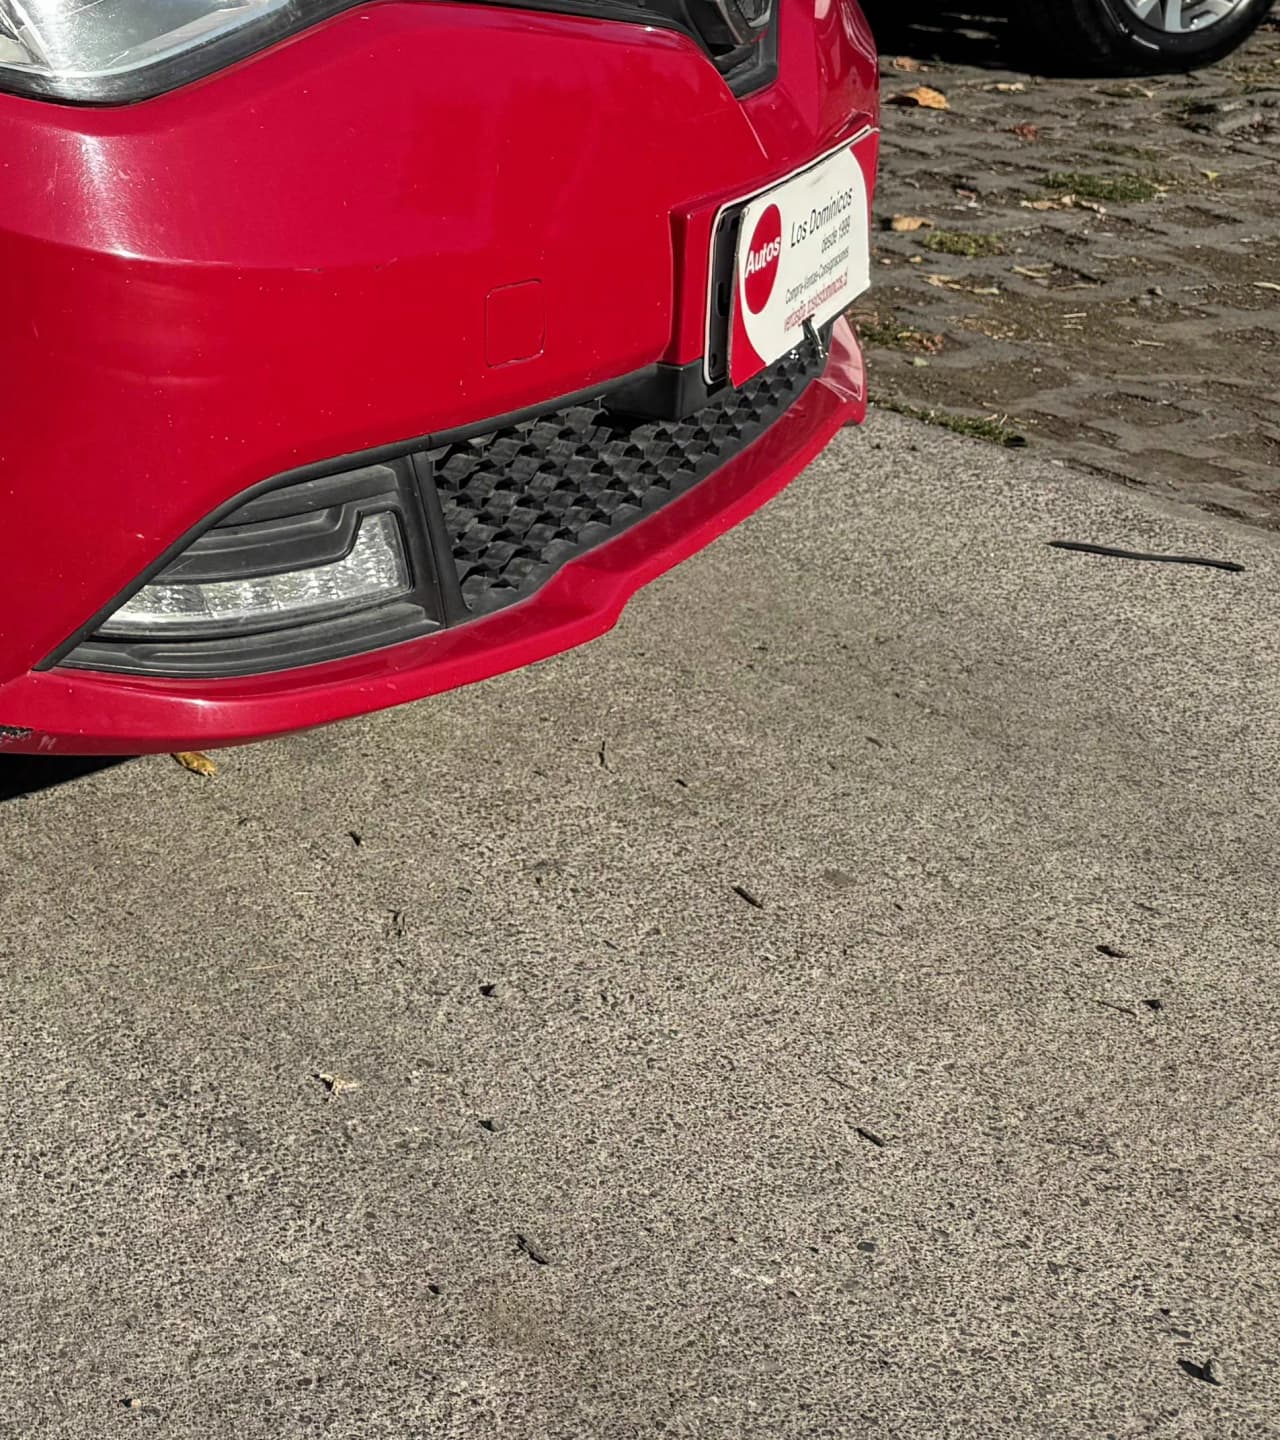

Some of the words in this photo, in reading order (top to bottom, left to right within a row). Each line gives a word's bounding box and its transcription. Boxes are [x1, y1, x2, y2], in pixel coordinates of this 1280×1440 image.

[790, 219, 807, 248] Los
[809, 188, 853, 236] Dominicos
[744, 236, 781, 279] Autos
